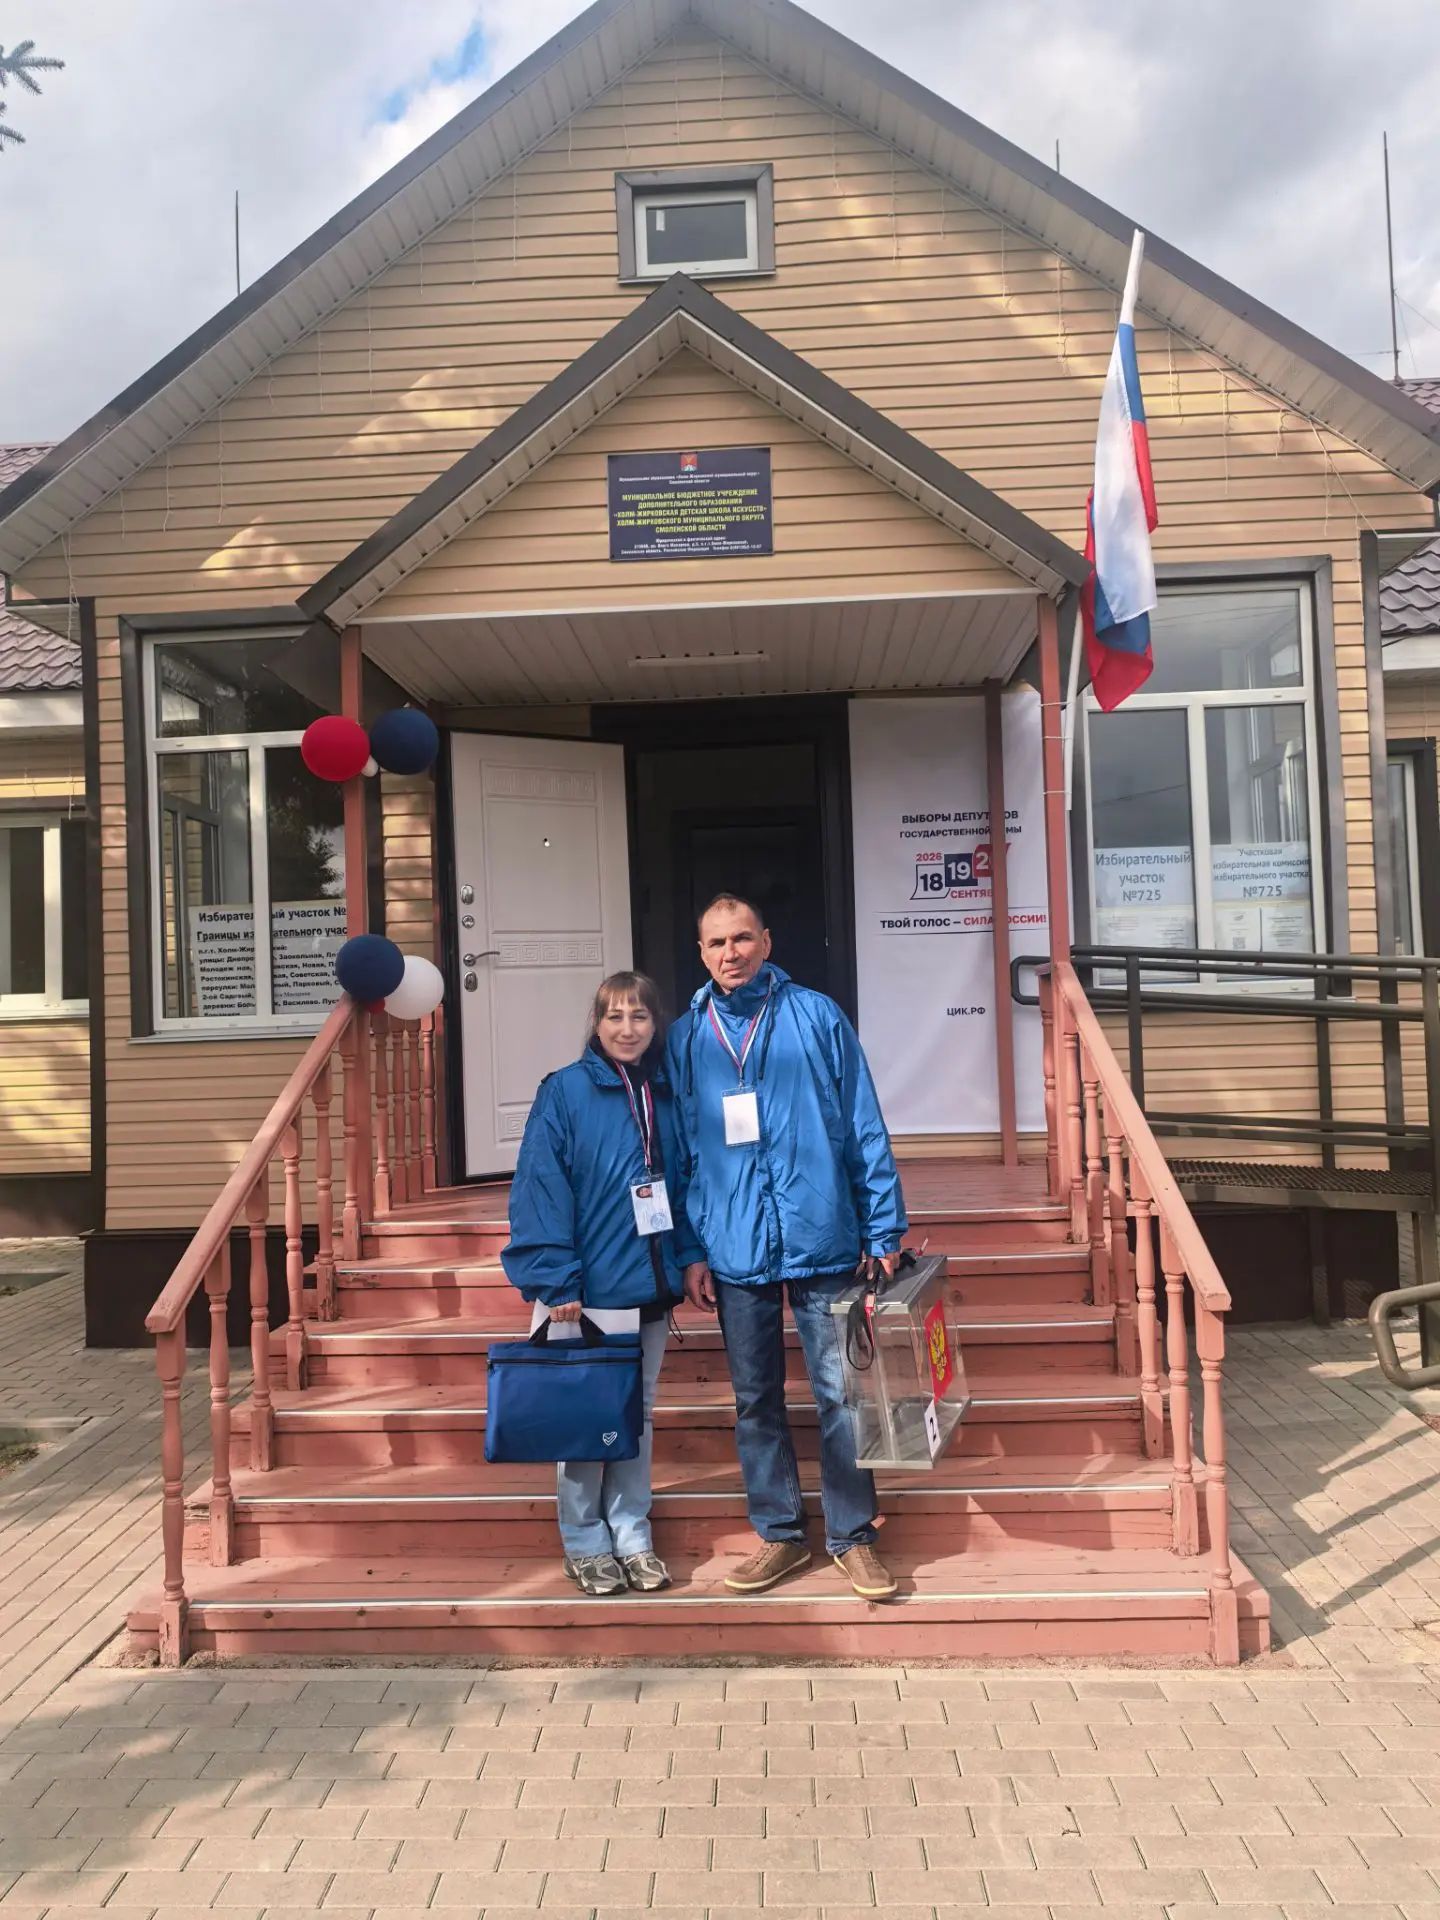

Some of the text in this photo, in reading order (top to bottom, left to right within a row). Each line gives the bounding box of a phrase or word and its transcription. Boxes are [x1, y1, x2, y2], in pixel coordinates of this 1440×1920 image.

[622, 488, 758, 501] МУНИЦИПАЛЬНОЕ БЮДЖЕТНОЕ УЧРЕЖДЕНИЕ
[638, 498, 743, 510] ДОПОЛНИТЕЛЬНОГО ОБРАЗОВАНИЯ
[614, 509, 679, 518] «ХОЛМ-ЖИРКОВСКАЯ
[680, 508, 707, 516] ДЕТСКАЯ
[732, 505, 767, 513] ИСКУССТВ»
[616, 517, 681, 526] ХОЛМ-ЖИРКОВСКОГО
[682, 515, 741, 524] МУНИЦИПАЛЬНОГО
[656, 524, 727, 534] СМОЛЕНСКОЙ ОБЛАСТИ
[902, 810, 1019, 824] ВЫБОРЫ ДЕПУТОВ
[900, 826, 991, 838] ГОСУДАРСТВЕННОЙ
[1239, 848, 1283, 857] Участковая
[1096, 852, 1192, 868] Избирательный
[1212, 860, 1270, 870] избирательная
[920, 852, 991, 892] 18 19 2
[1214, 871, 1309, 882] избирательного участка
[1118, 874, 1165, 887] участок
[1122, 890, 1161, 902] №725
[1242, 886, 1282, 898] №725
[199, 910, 284, 923] Избирателый
[288, 907, 330, 920] участок
[880, 918, 911, 930] ТВОЙ
[914, 917, 950, 928] ГОЛОС
[964, 914, 994, 926] СИЛА
[1007, 913, 1048, 924] ОССИИ!
[197, 926, 348, 942] Границы изательного учас
[218, 944, 288, 954] Холм-Жиркий:
[947, 1006, 986, 1017] ЦИК.РФ
